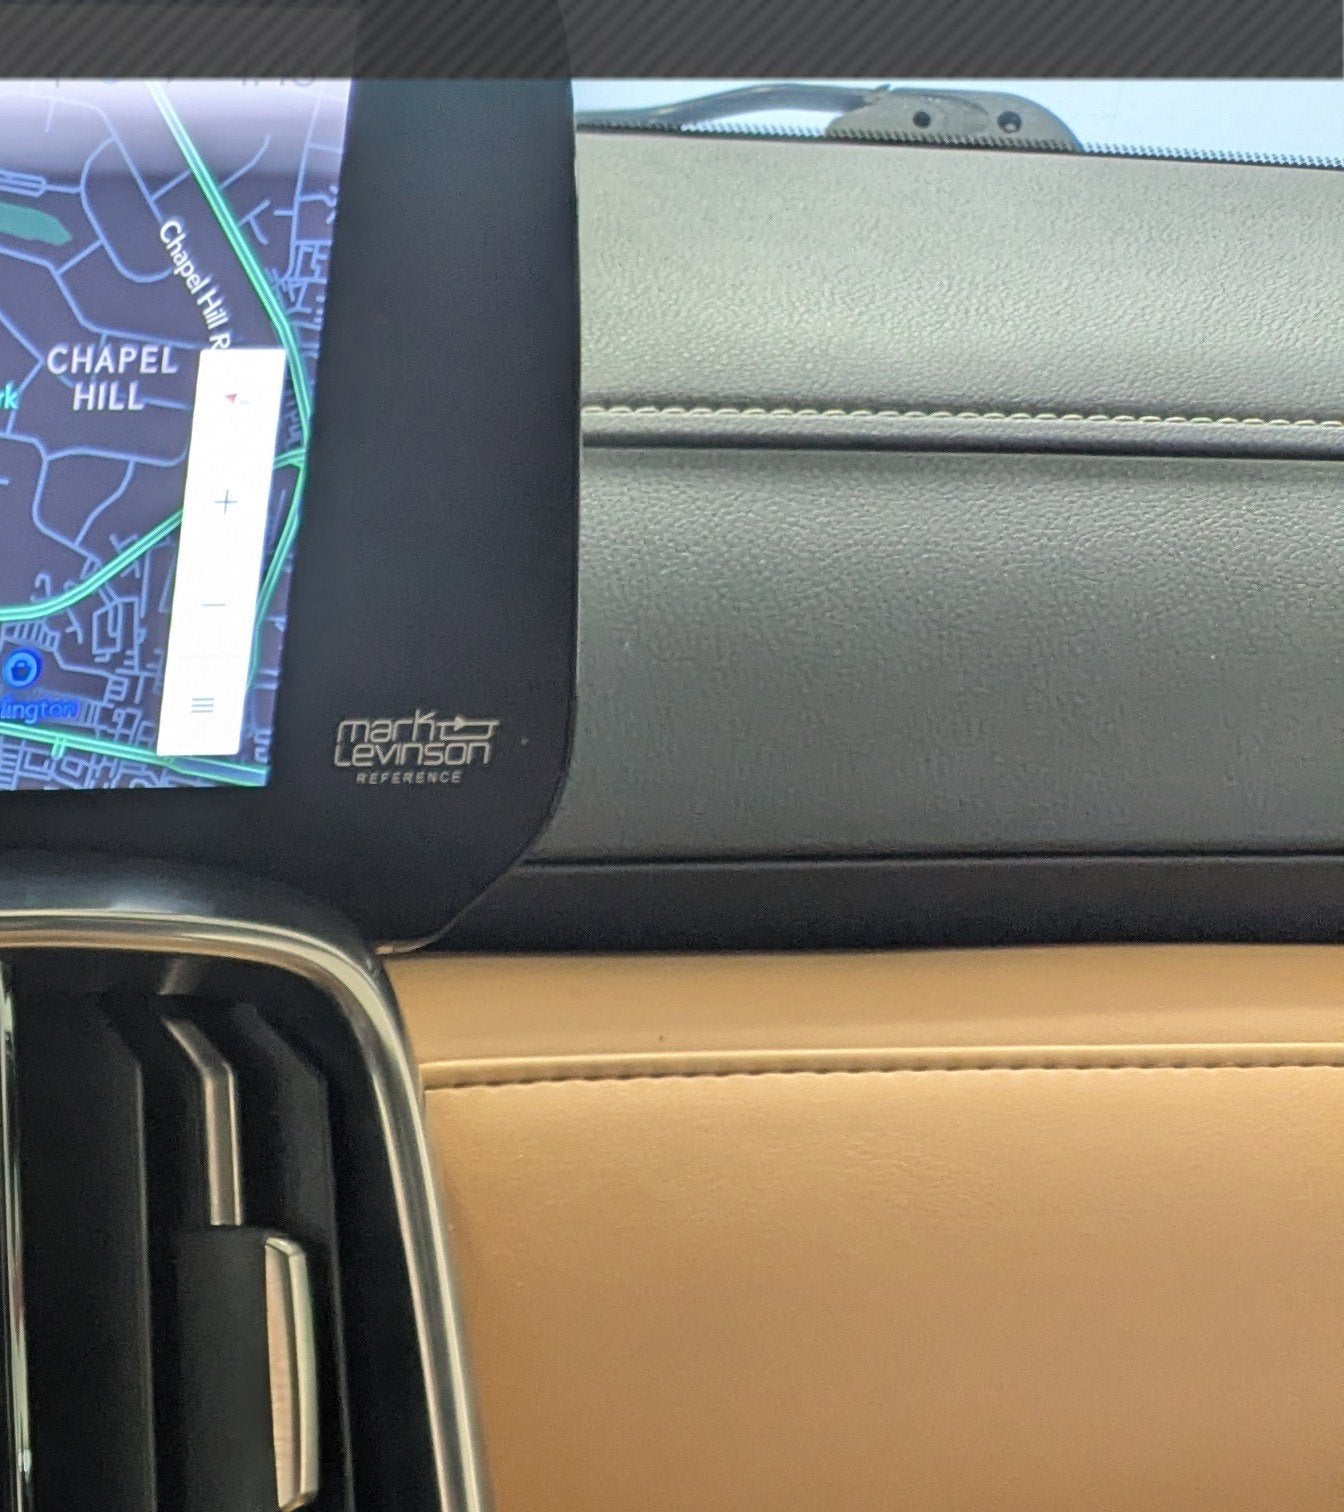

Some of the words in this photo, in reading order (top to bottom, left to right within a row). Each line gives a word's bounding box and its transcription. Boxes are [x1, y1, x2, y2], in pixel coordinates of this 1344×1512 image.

[159, 220, 205, 295] Chapel
[196, 284, 230, 331] Hill
[46, 344, 178, 375] CHAPEL
[73, 381, 145, 411] HILL
[356, 771, 462, 785] REFERENCE
